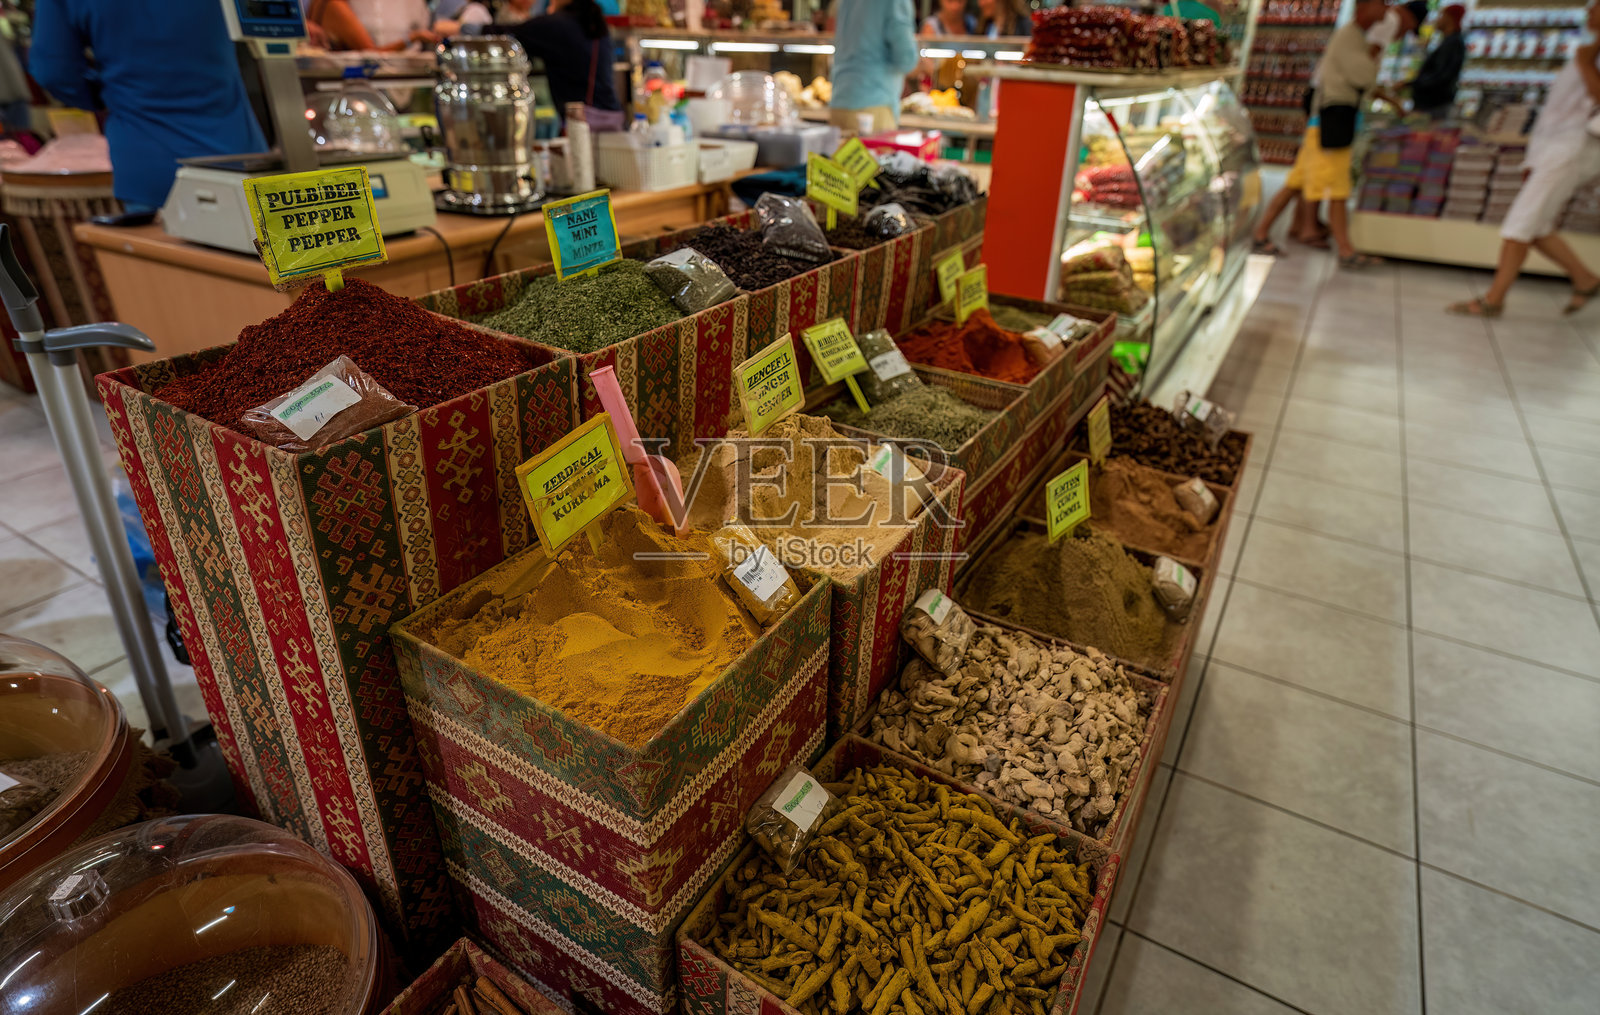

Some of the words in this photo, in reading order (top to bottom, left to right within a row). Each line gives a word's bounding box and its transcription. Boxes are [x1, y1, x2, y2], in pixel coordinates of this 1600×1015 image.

[281, 205, 356, 229] PEPPER
[567, 208, 598, 226] NANE
[288, 227, 361, 252] PEPPER
